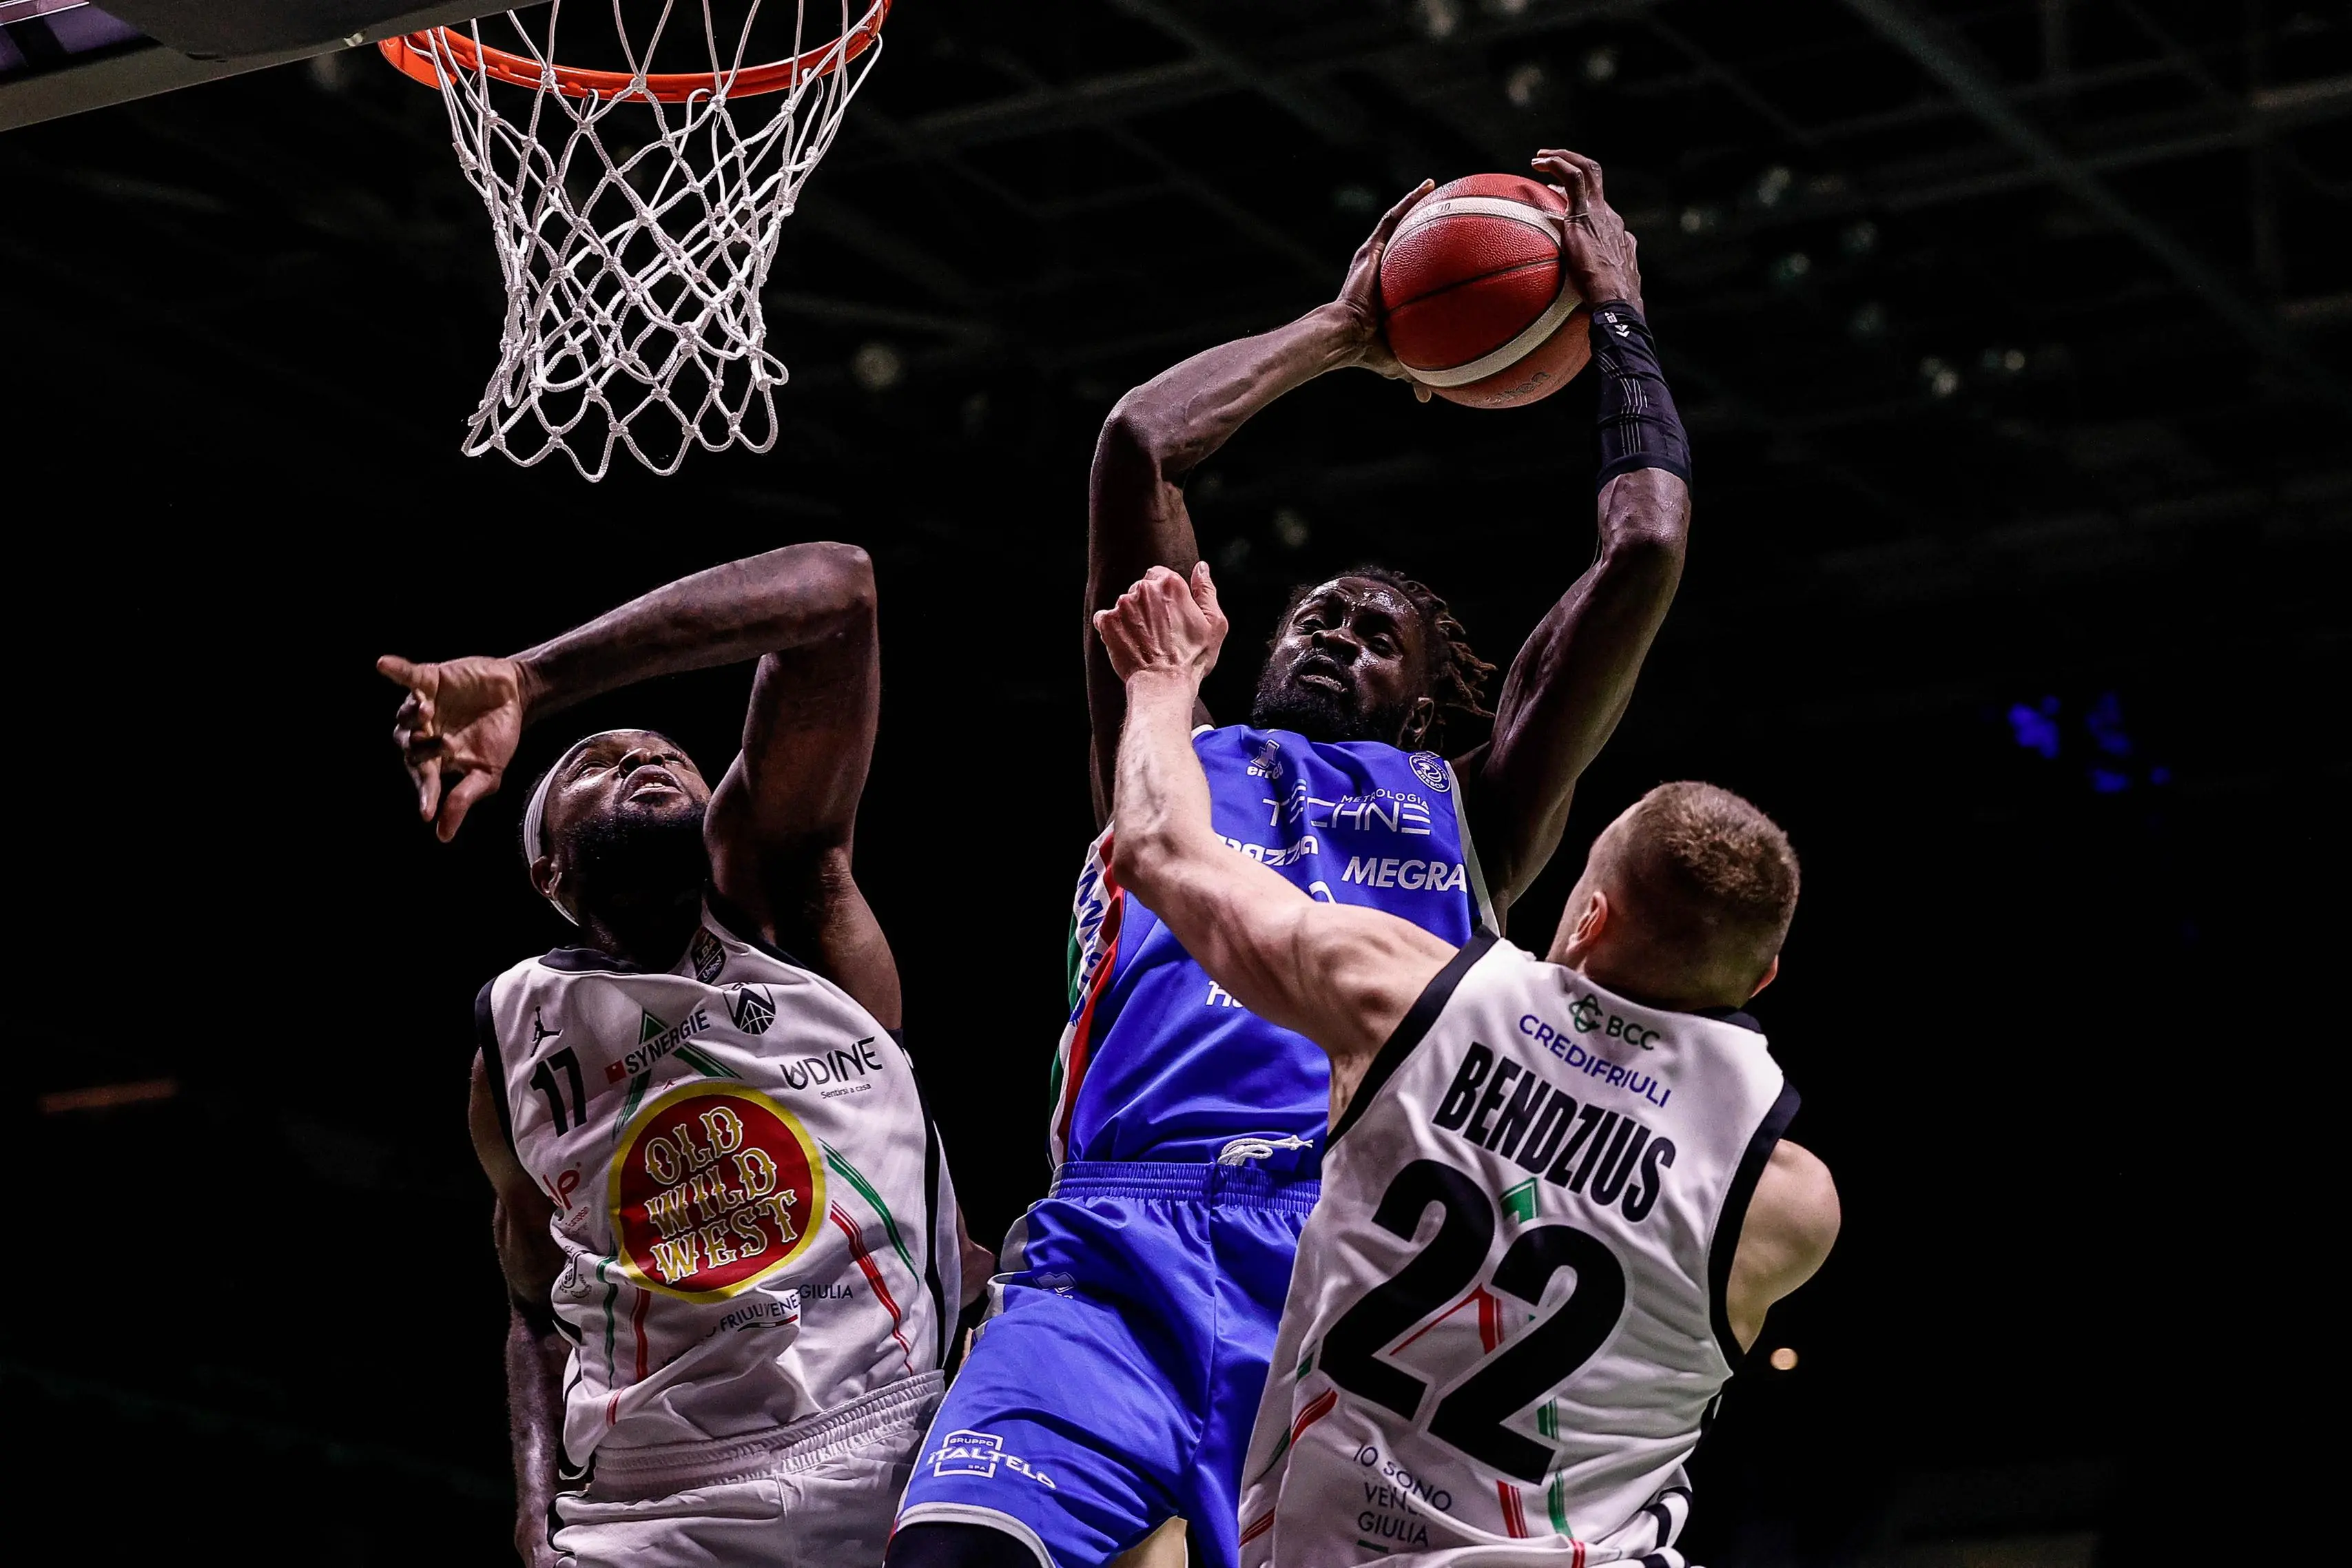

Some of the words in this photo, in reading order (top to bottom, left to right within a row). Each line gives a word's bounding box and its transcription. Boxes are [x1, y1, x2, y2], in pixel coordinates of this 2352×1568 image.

[1340, 788, 1430, 811] METROLOGIA
[1341, 856, 1467, 894] MEGRA
[624, 1009, 711, 1074] SYNERGIE
[778, 1035, 884, 1091] UDINE
[1519, 1014, 1672, 1108] CREDIFRIULI
[1605, 1015, 1661, 1051] BCC
[529, 1046, 588, 1138] 17
[821, 1086, 849, 1100] Sentirsi
[856, 1083, 871, 1093] casa
[645, 1106, 743, 1185] OLD
[1432, 1041, 1677, 1224] BENDZIUS
[644, 1147, 777, 1239] WILD
[650, 1189, 798, 1285] WEST
[798, 1283, 854, 1299] GIULIA
[1318, 1158, 1627, 1486] 22
[949, 1437, 994, 1447] GRUPPO
[1353, 1443, 1379, 1467] IO
[1383, 1461, 1452, 1512] SONO
[1365, 1482, 1422, 1516] VEN
[1358, 1511, 1429, 1547] GIULIA
